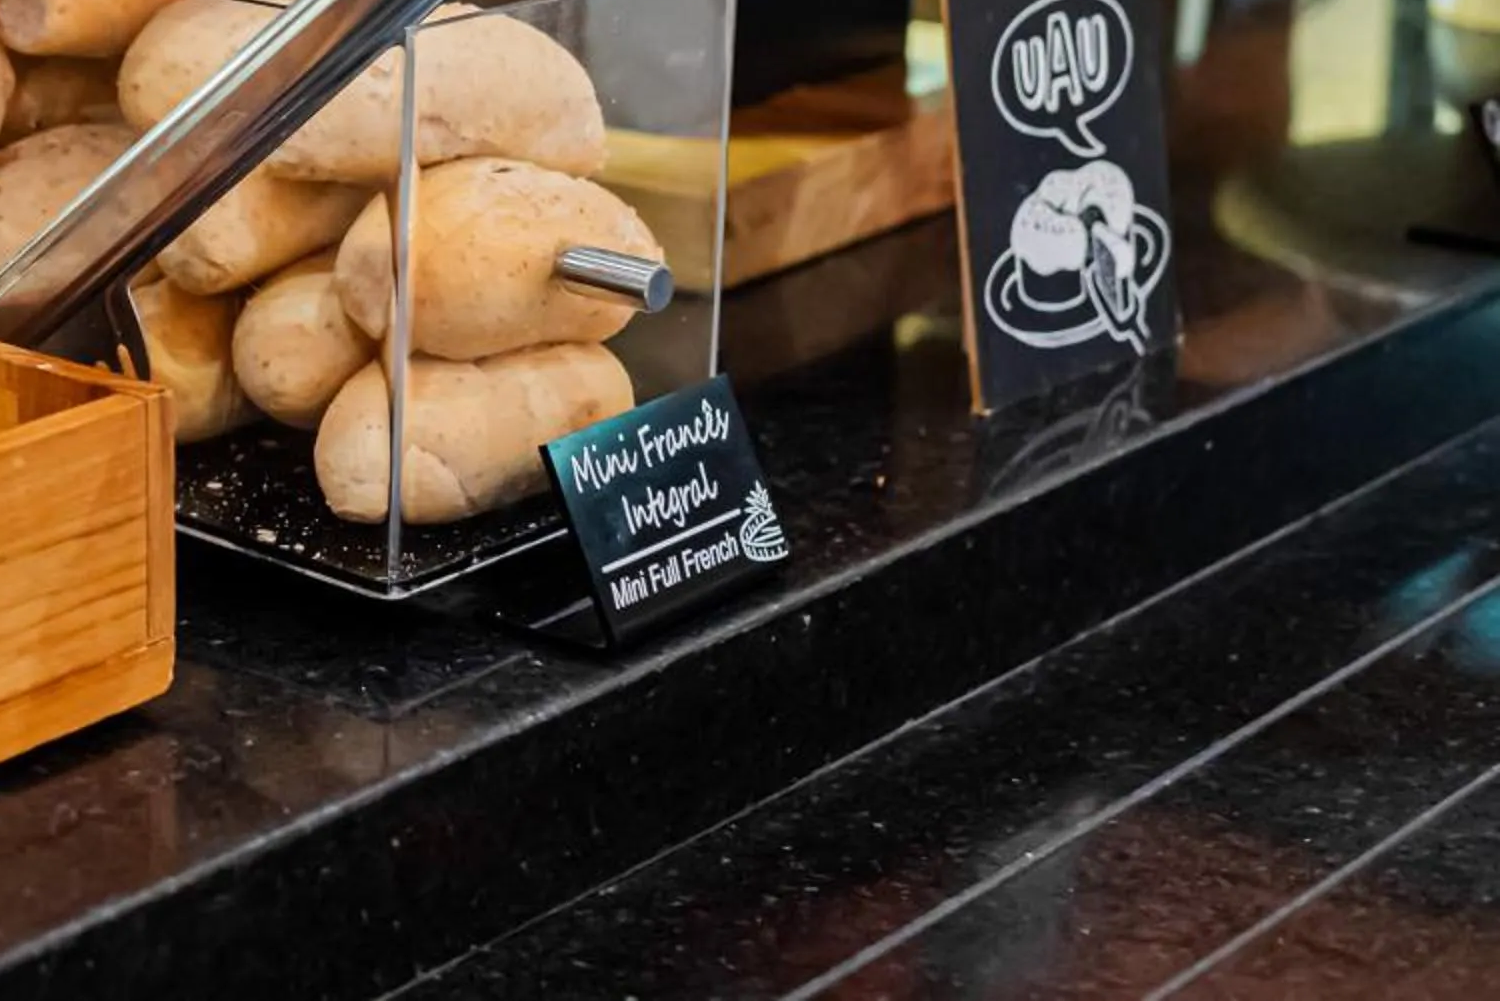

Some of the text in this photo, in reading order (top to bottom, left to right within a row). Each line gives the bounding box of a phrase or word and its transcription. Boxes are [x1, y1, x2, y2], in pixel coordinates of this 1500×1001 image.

[1011, 11, 1111, 113] UAU
[570, 398, 730, 494] Mini Francês
[620, 461, 718, 535] Integral
[610, 531, 739, 610] Mini Full French
